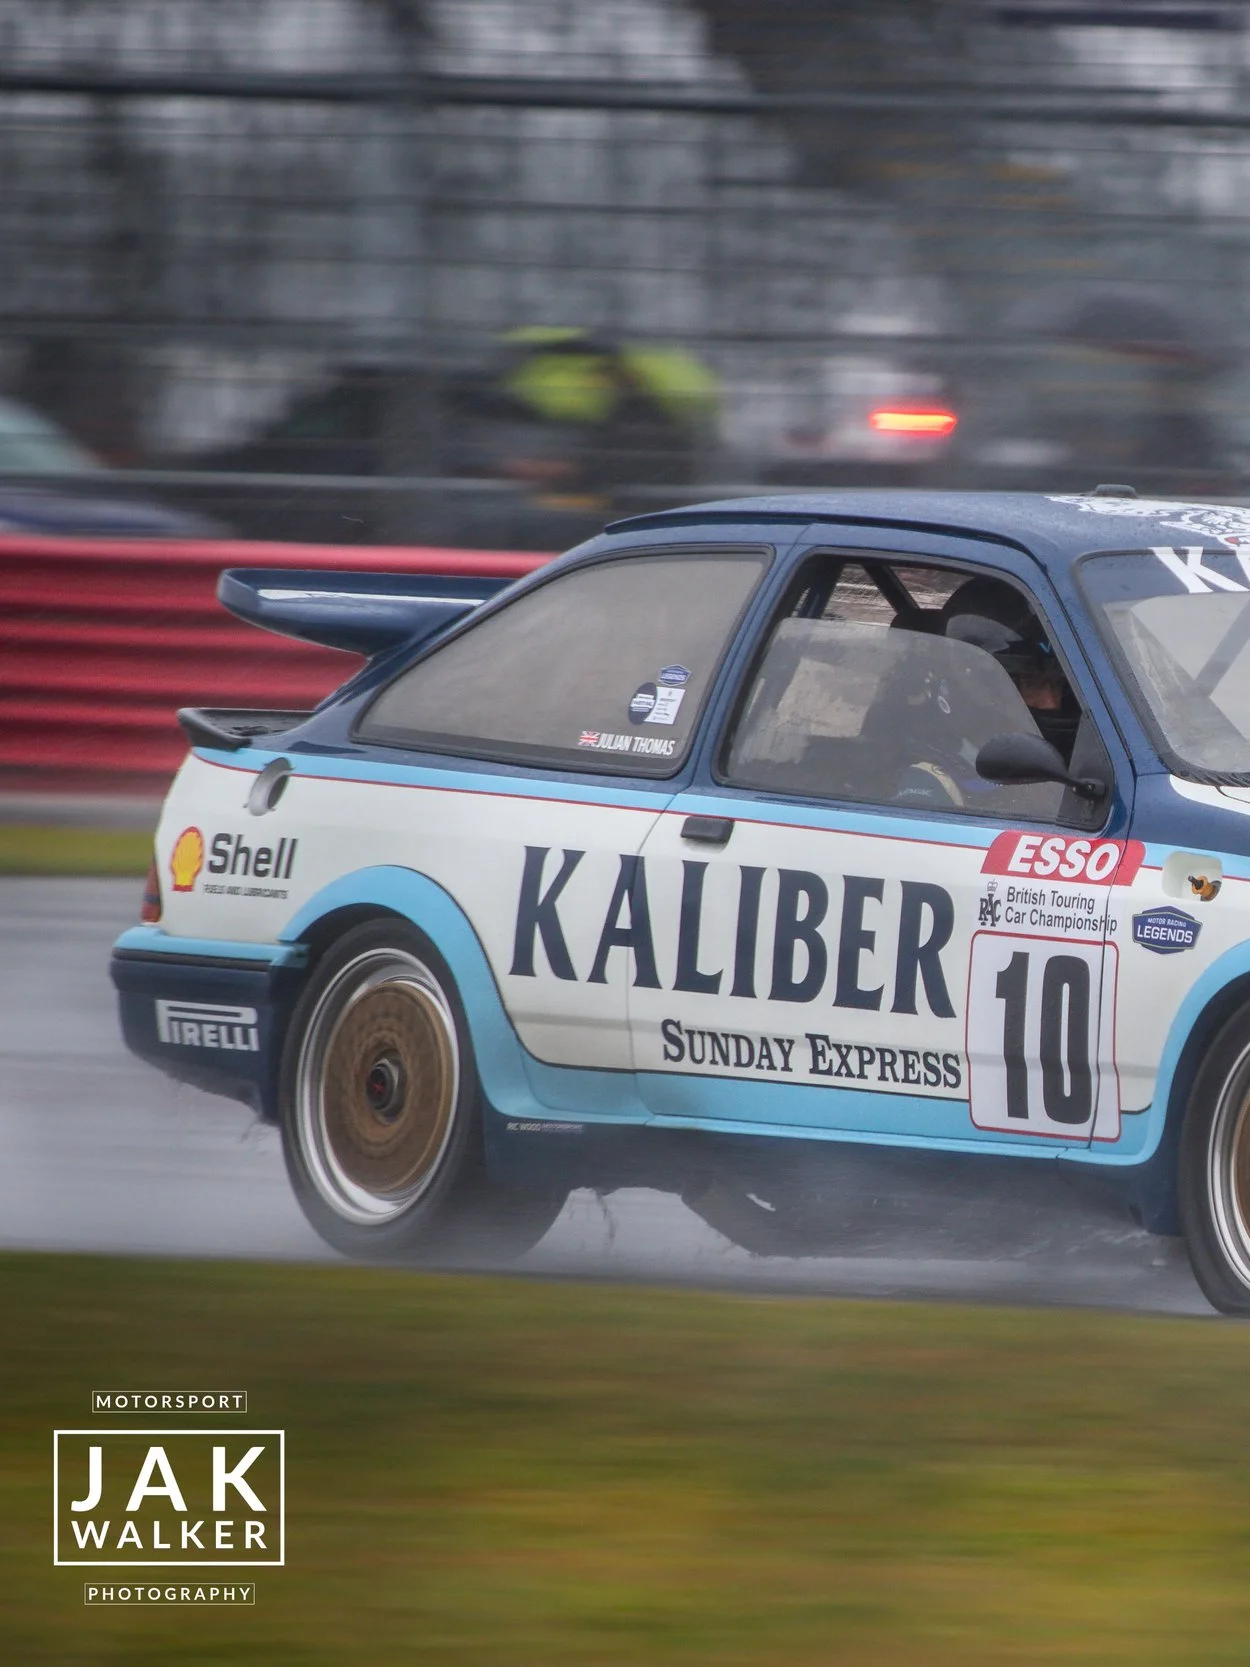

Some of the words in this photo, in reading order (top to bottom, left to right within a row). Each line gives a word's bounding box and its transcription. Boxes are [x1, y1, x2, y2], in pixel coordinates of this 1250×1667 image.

[596, 733, 632, 751] JULIAN
[632, 736, 675, 755] THOMAS
[208, 833, 299, 879] Shell
[1007, 836, 1120, 881] ESSO
[1005, 907, 1027, 924] Car
[1029, 911, 1117, 935] Championship
[1006, 886, 1046, 906] British
[1050, 890, 1095, 914] Touring
[1147, 917, 1166, 926] MOTOR
[1166, 918, 1187, 928] RACING
[508, 845, 957, 1018] KALIBER
[1137, 925, 1194, 943] LEGENDS
[155, 999, 260, 1052] PIRELLI
[995, 951, 1092, 1125] 10
[661, 1018, 795, 1072] SUNDAY
[805, 1033, 962, 1089] EXPRESS
